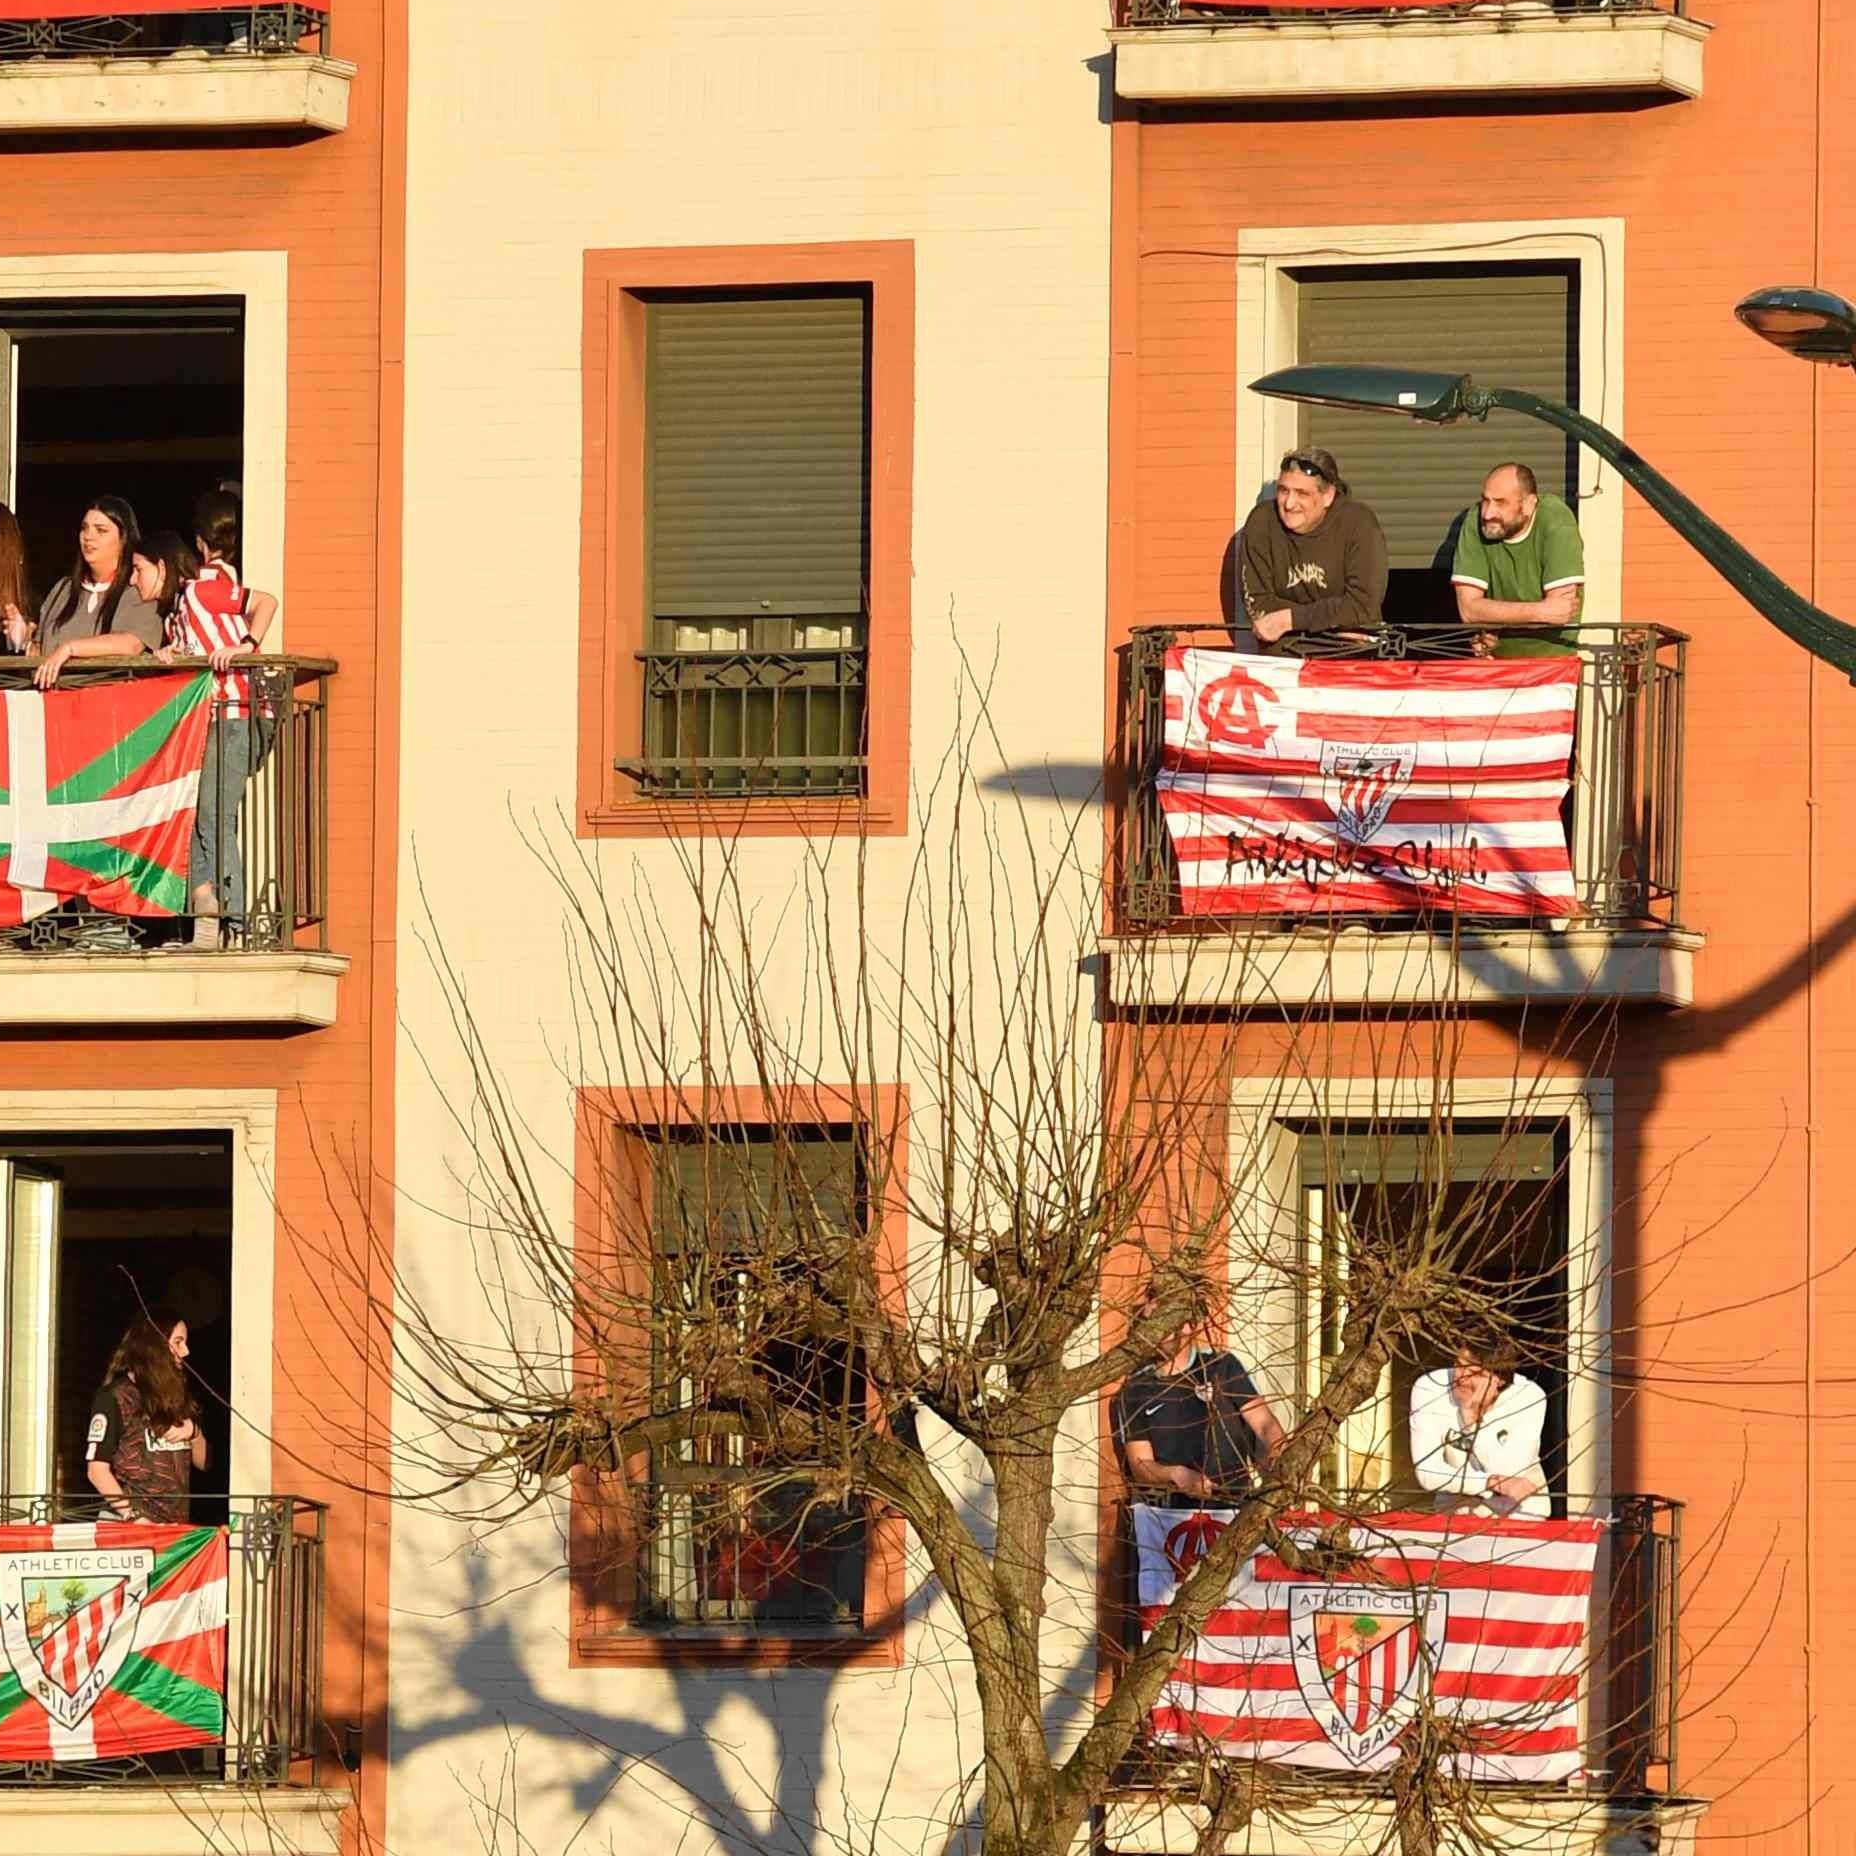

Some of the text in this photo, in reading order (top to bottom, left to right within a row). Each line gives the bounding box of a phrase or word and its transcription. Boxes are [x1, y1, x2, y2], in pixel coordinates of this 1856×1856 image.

[7, 1555, 145, 1572] ATHLETIC CLUB
[1299, 1592, 1385, 1609] ATHLETIC
[37, 1668, 105, 1721] BILBAO
